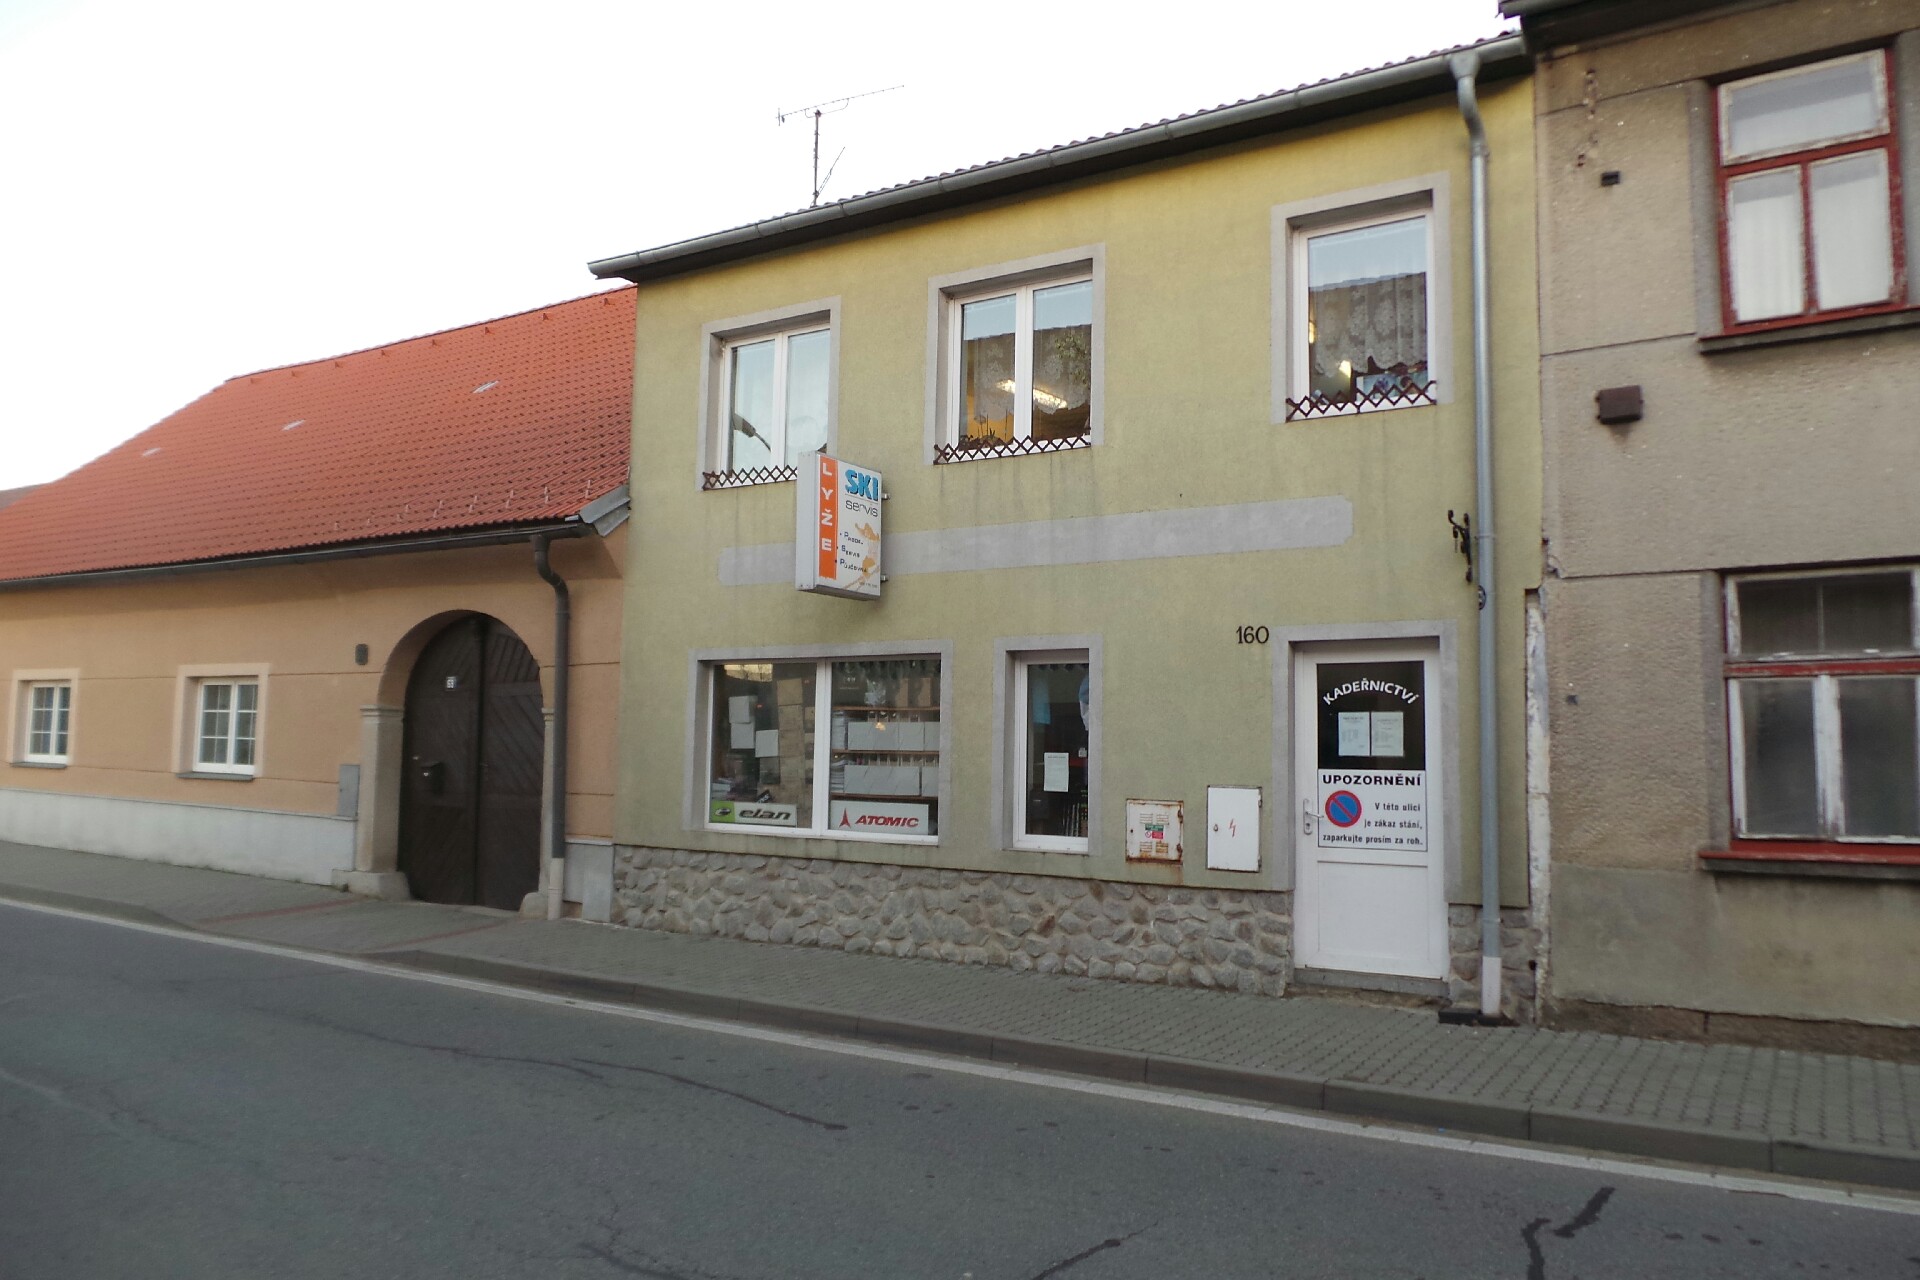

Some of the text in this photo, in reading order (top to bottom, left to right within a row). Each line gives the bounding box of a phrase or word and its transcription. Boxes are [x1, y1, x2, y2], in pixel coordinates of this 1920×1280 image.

[845, 469, 879, 502] SKI
[821, 462, 833, 552] LYŽE
[1236, 625, 1270, 644] 160
[1322, 677, 1420, 705] KADEŘNICTVÍ
[1322, 773, 1421, 786] UPOZORNĚNÍ
[1374, 802, 1421, 812] V této ulici
[739, 809, 791, 820] elan
[855, 814, 920, 828] ATOMIC
[1364, 818, 1371, 828] je
[1374, 819, 1396, 828] zákaz
[1322, 834, 1363, 844] zaparkujte
[1365, 835, 1392, 845] prosím
